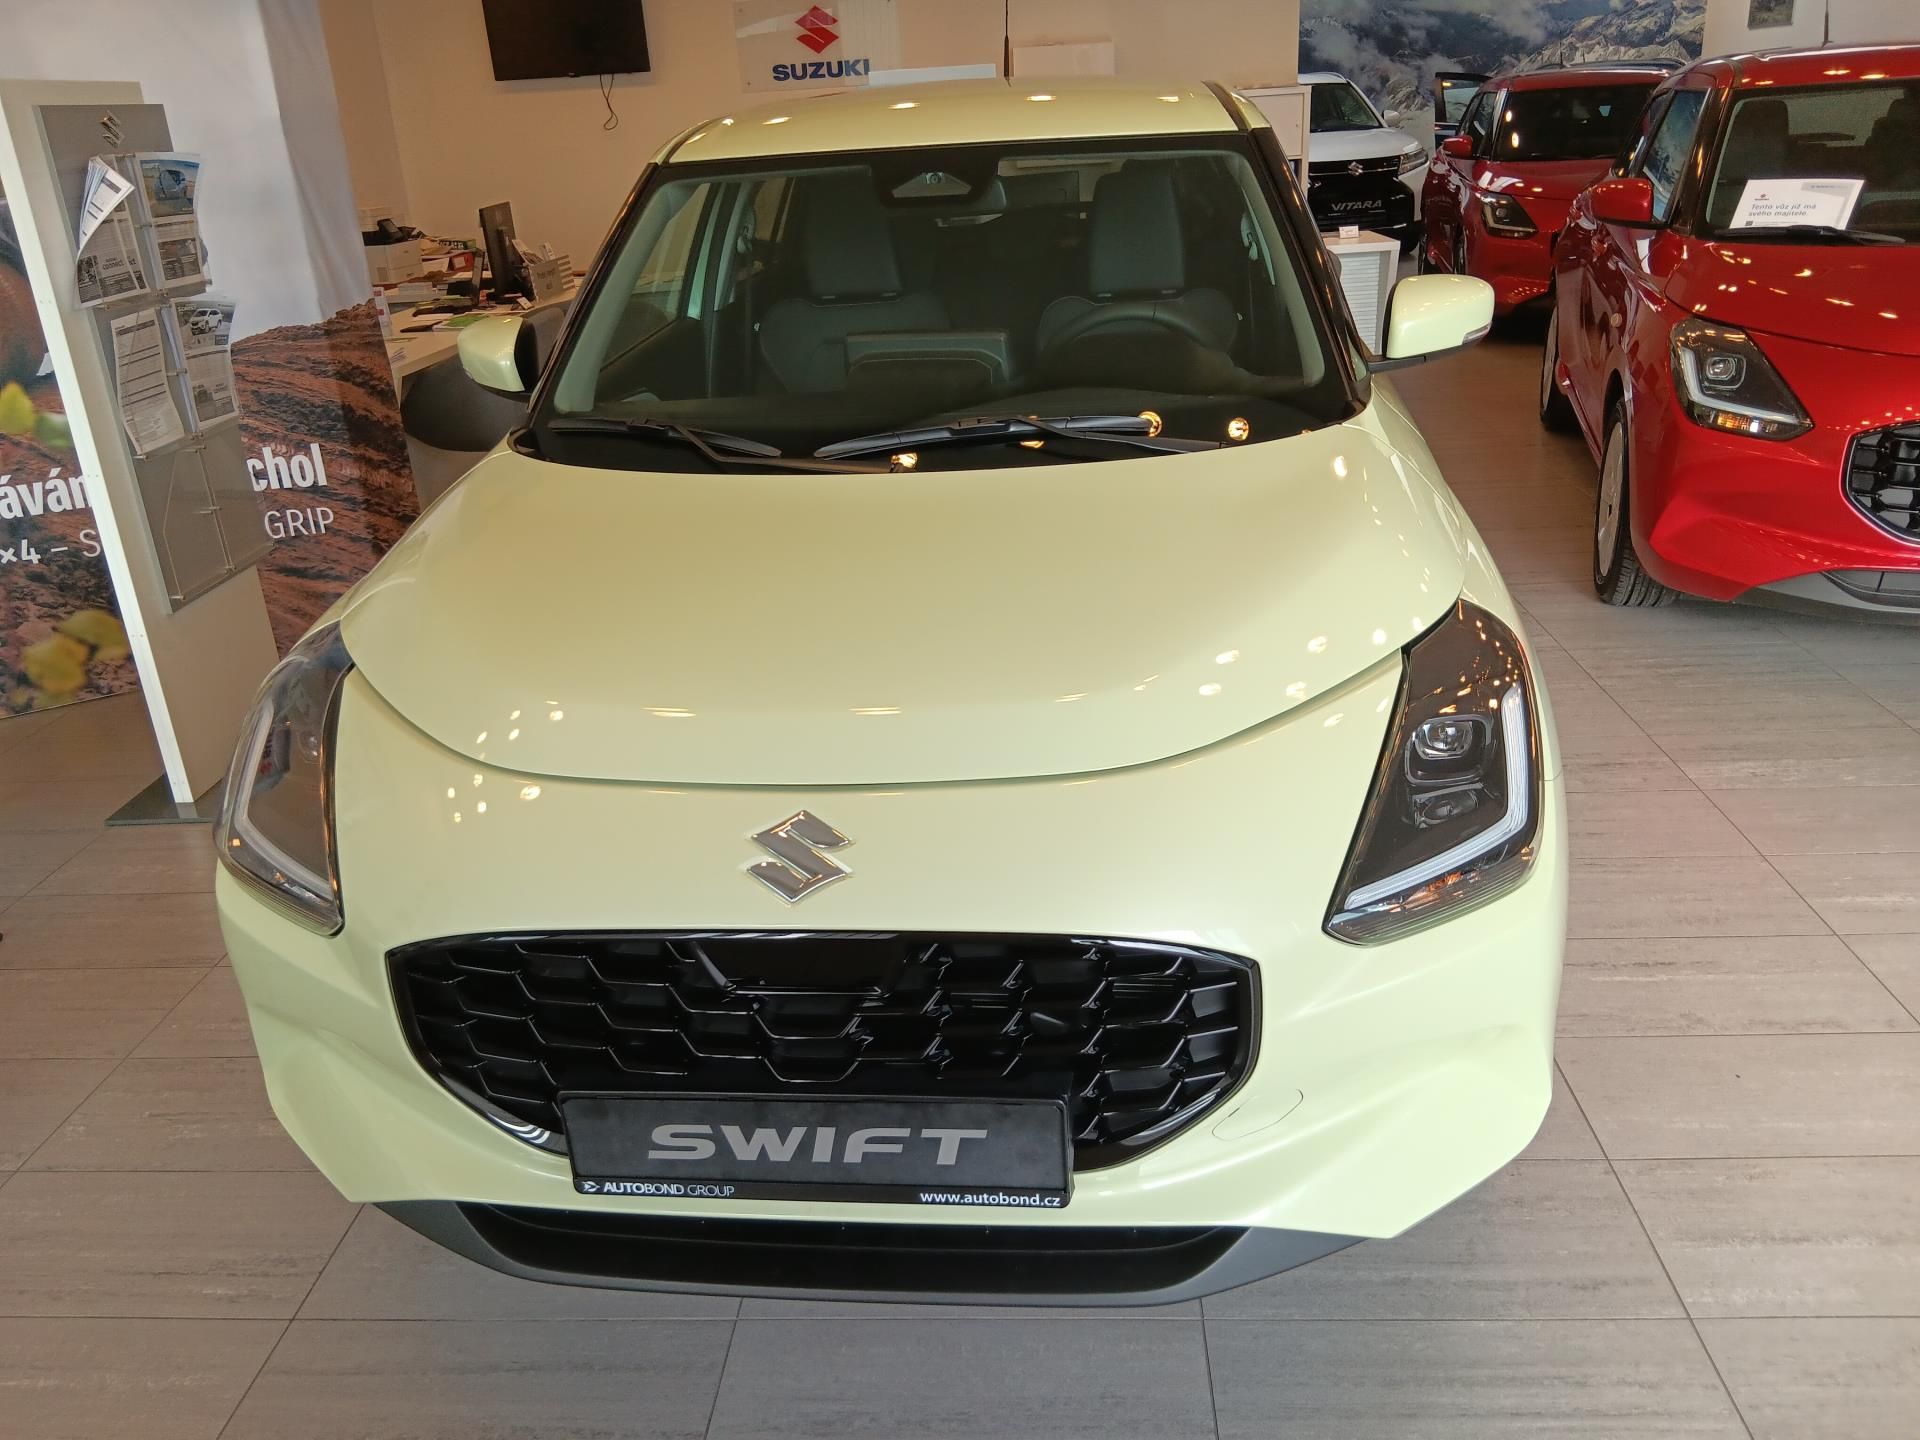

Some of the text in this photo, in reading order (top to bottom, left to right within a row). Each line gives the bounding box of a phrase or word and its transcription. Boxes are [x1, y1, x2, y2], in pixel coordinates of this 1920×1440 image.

[772, 59, 870, 82] SUZUKI
[1331, 200, 1382, 211] VITARA
[246, 443, 328, 492] chol
[264, 507, 334, 539] GRIP
[648, 1124, 988, 1166] SWIFT
[603, 1181, 1061, 1206] AUTOBOND GROUP www.autobond.cz
